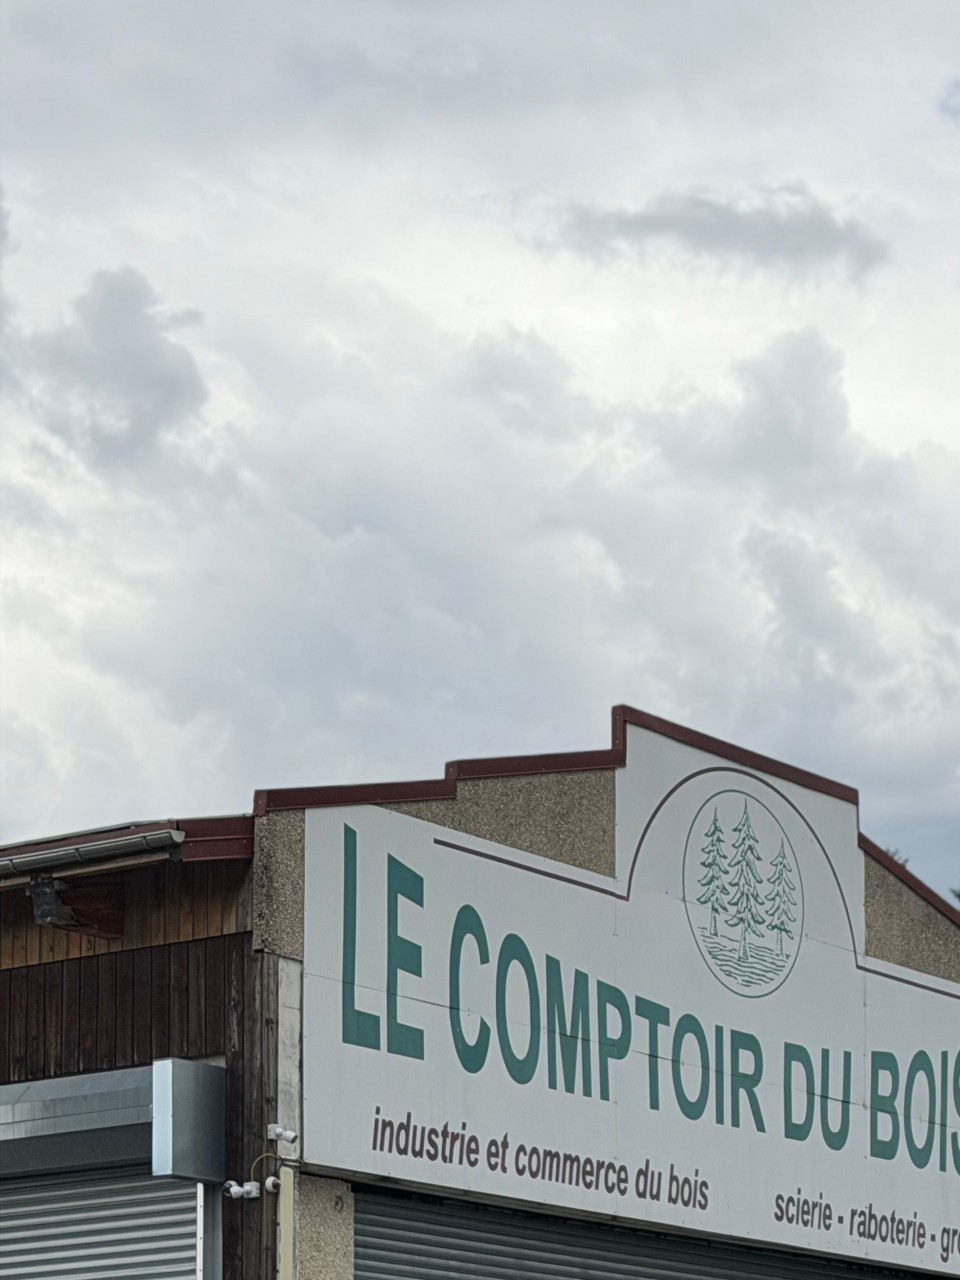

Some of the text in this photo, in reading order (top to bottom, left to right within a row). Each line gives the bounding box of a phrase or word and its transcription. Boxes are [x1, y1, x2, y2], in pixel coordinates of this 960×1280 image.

[341, 822, 425, 1061] LE
[448, 903, 767, 1134] COMPTOIR
[783, 1041, 852, 1152] DU
[372, 1105, 710, 1211] industrie et commerce du bois
[774, 1187, 833, 1231] scierie
[849, 1203, 927, 1250] raboterie
